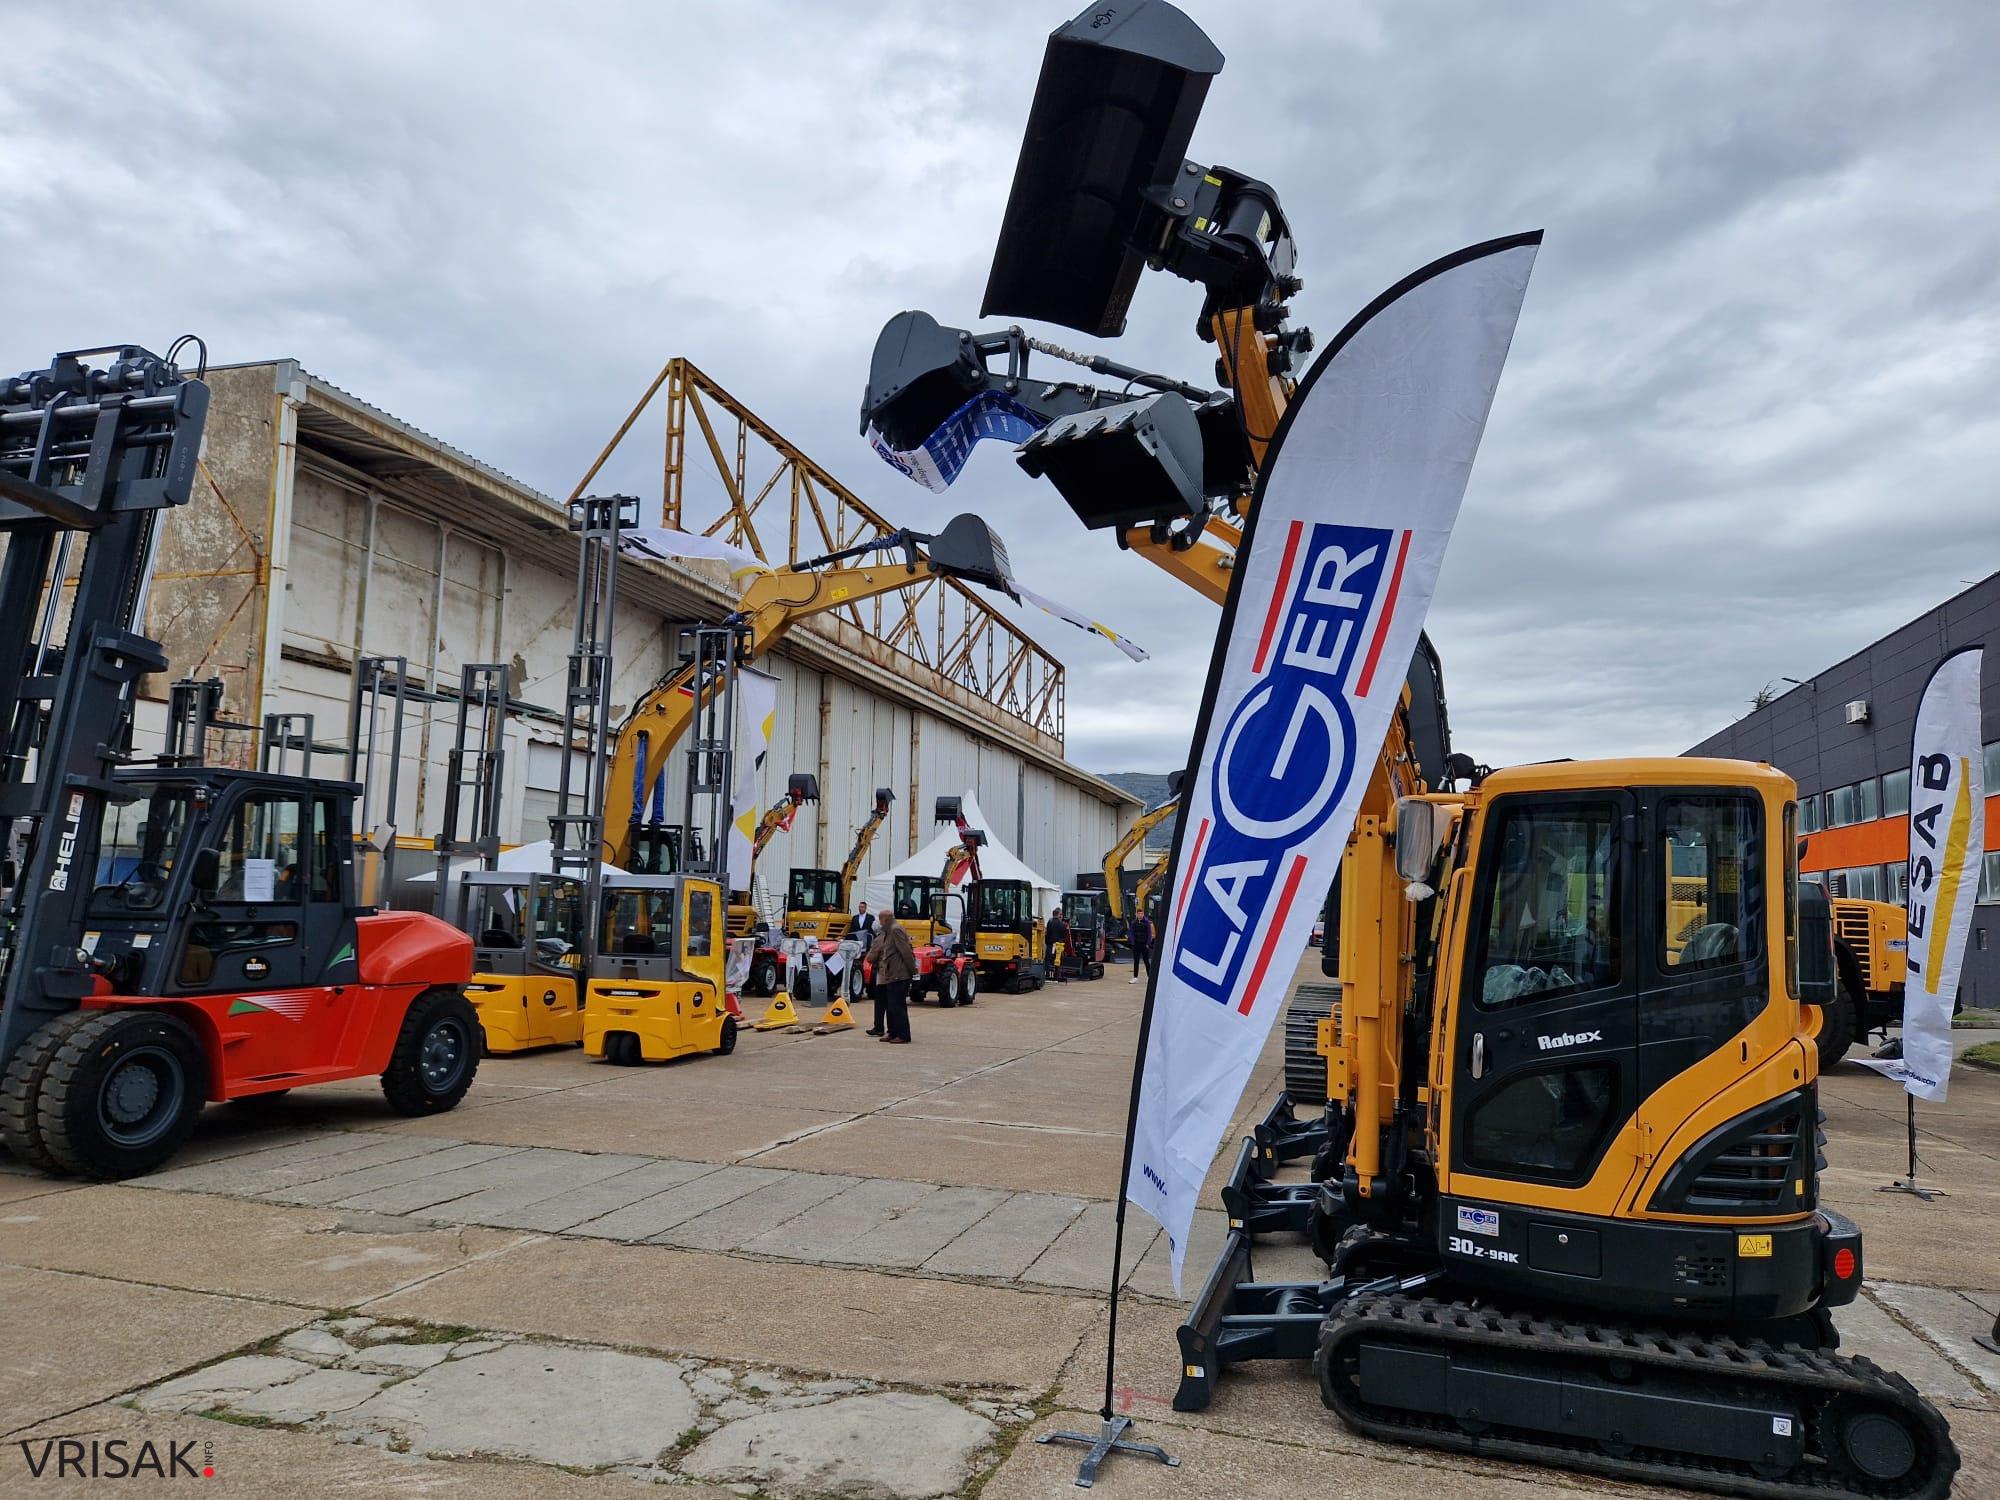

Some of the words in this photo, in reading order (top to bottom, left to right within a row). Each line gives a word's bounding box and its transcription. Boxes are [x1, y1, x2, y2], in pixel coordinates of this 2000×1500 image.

[1179, 544, 1380, 987] LAGER
[54, 814, 81, 878] HELI
[1459, 1209, 1497, 1225] LAGER
